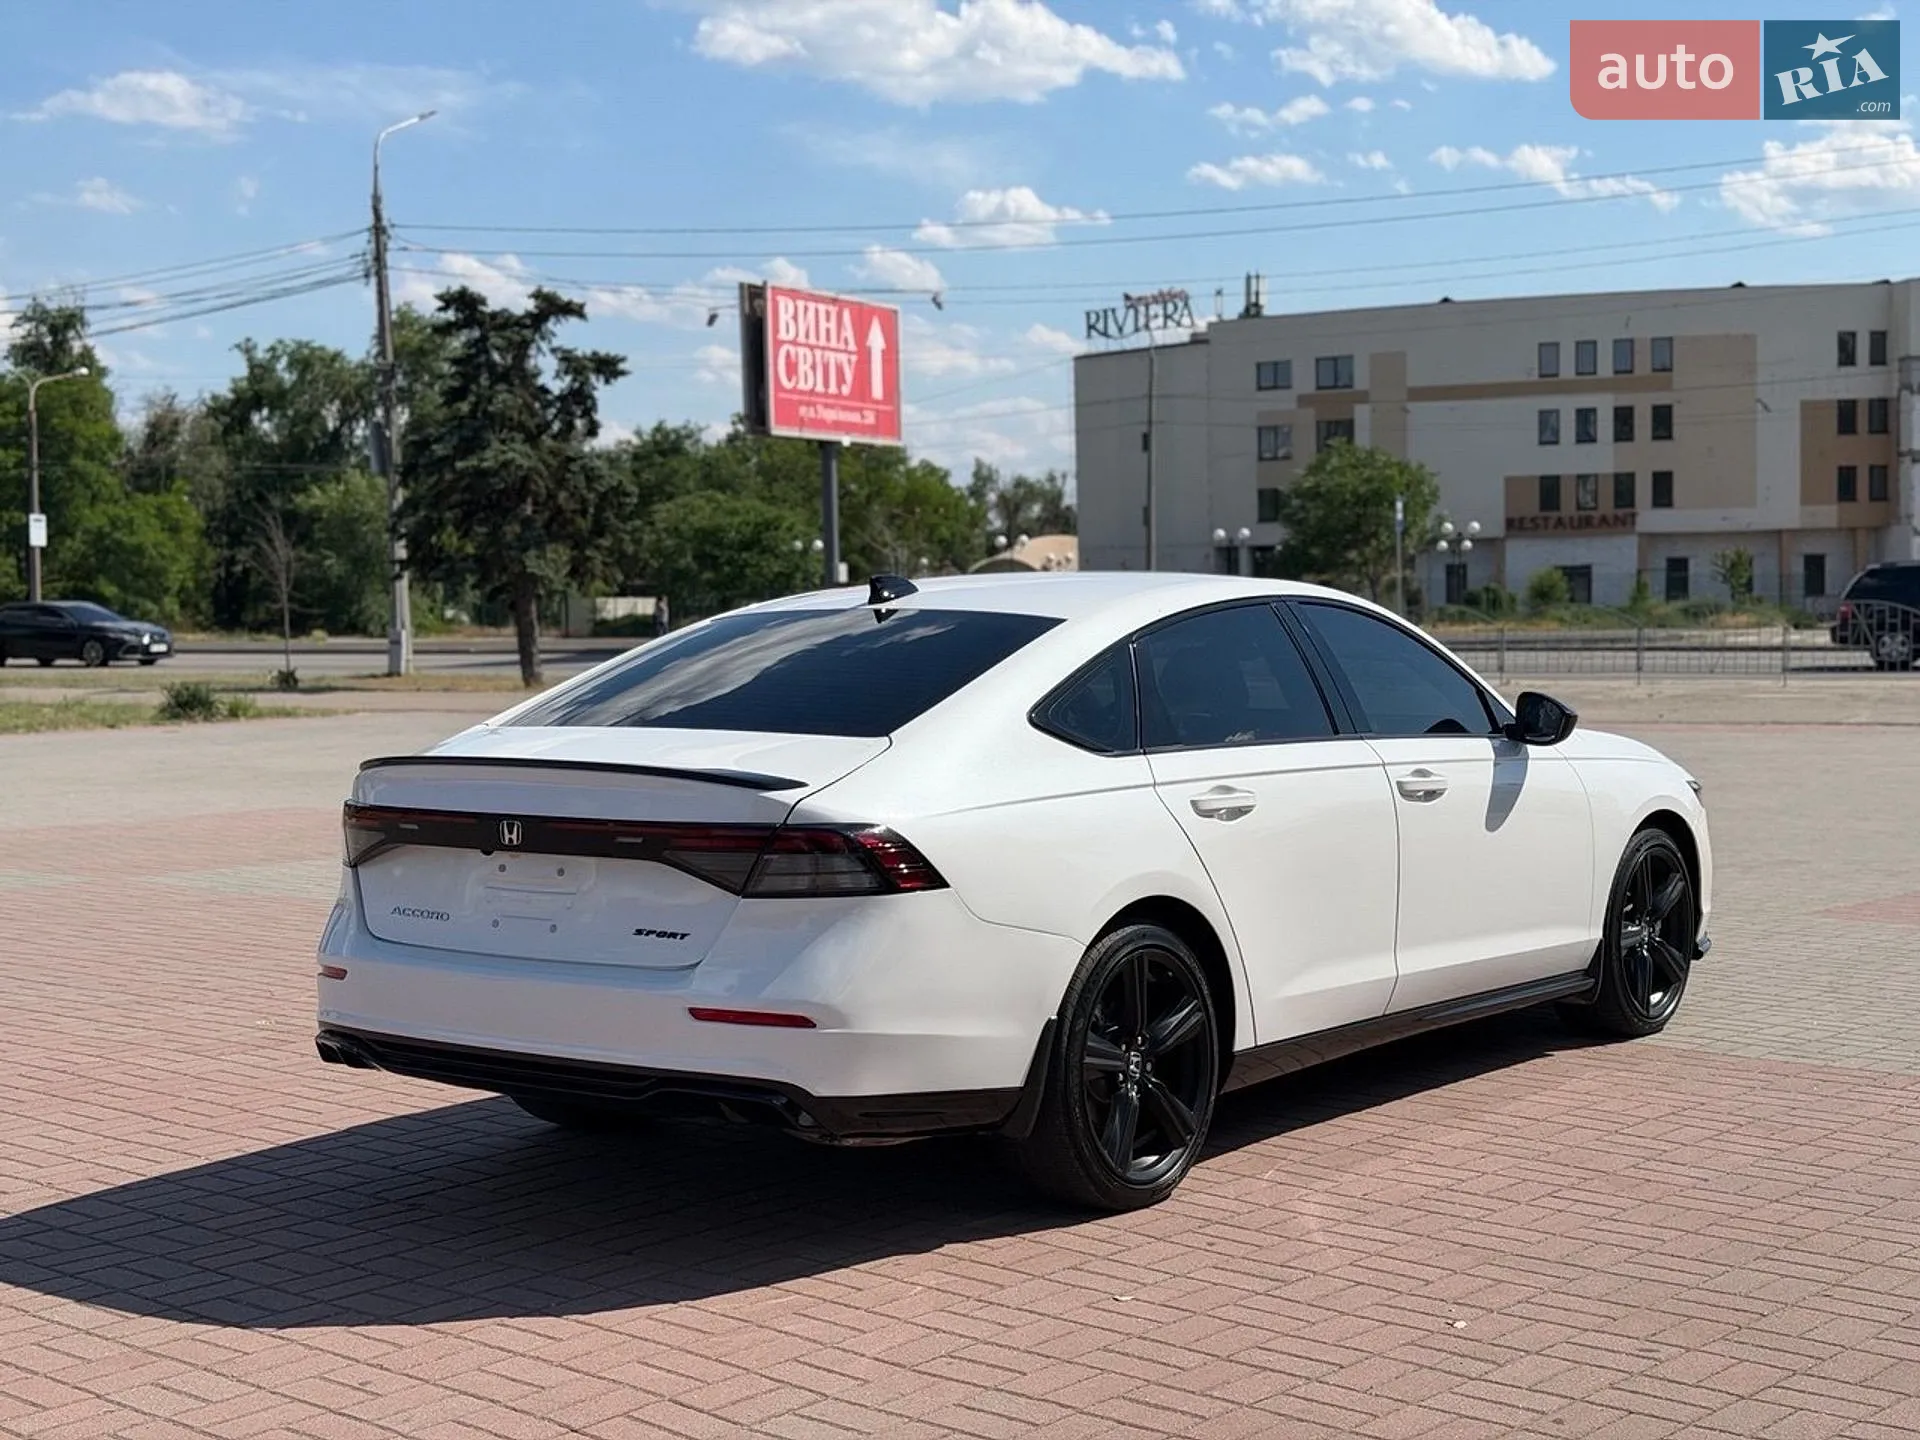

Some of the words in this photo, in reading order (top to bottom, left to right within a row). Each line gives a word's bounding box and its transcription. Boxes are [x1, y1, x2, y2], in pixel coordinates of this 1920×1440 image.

[776, 295, 858, 352] ВИНА
[1085, 299, 1195, 339] RIVIERA
[776, 343, 859, 396] СВІТУ
[1506, 511, 1639, 532] RESTAURANT
[632, 928, 691, 941] SPORT
